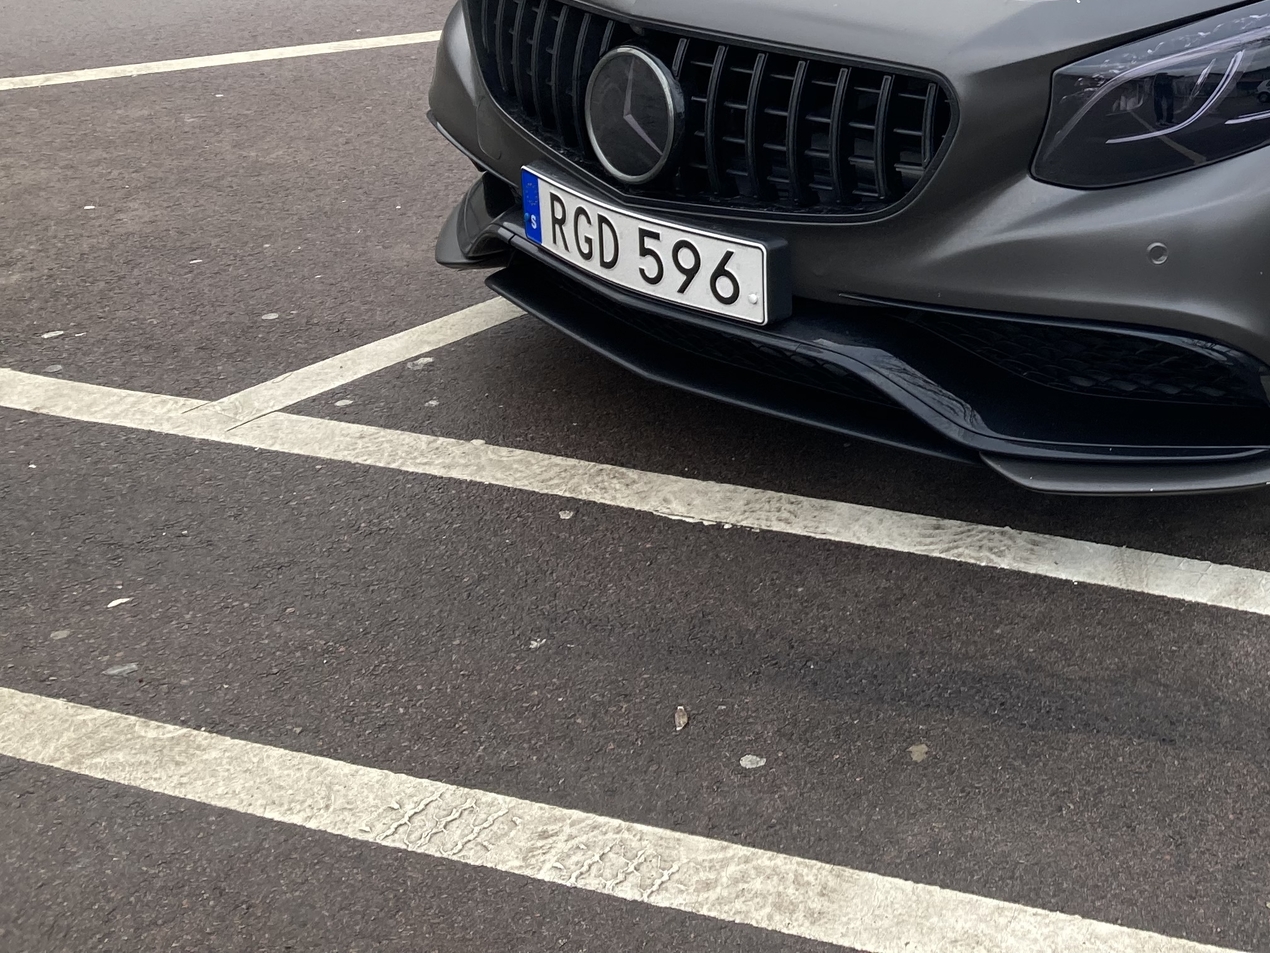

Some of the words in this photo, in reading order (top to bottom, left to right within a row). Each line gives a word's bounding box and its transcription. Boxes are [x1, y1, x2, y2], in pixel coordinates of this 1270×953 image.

[530, 213, 538, 230] S
[549, 191, 620, 270] RGD
[638, 226, 740, 305] 596
